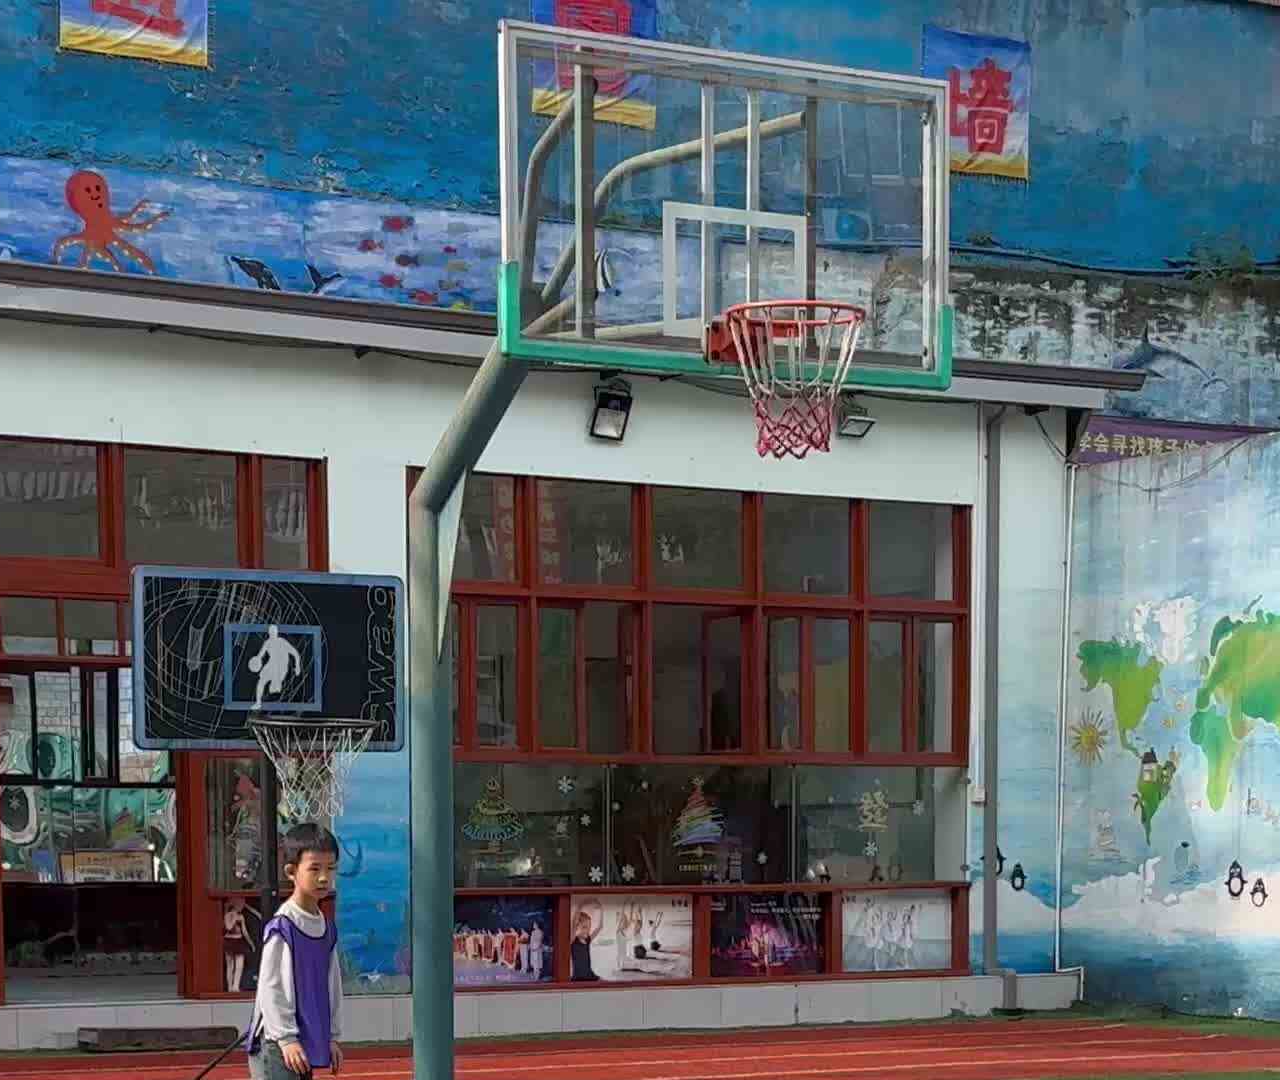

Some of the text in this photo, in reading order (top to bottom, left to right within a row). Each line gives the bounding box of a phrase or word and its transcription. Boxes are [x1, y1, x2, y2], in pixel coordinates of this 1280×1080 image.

[948, 57, 1013, 154] 墙
[1080, 432, 1216, 456] 学会寻找孩子
